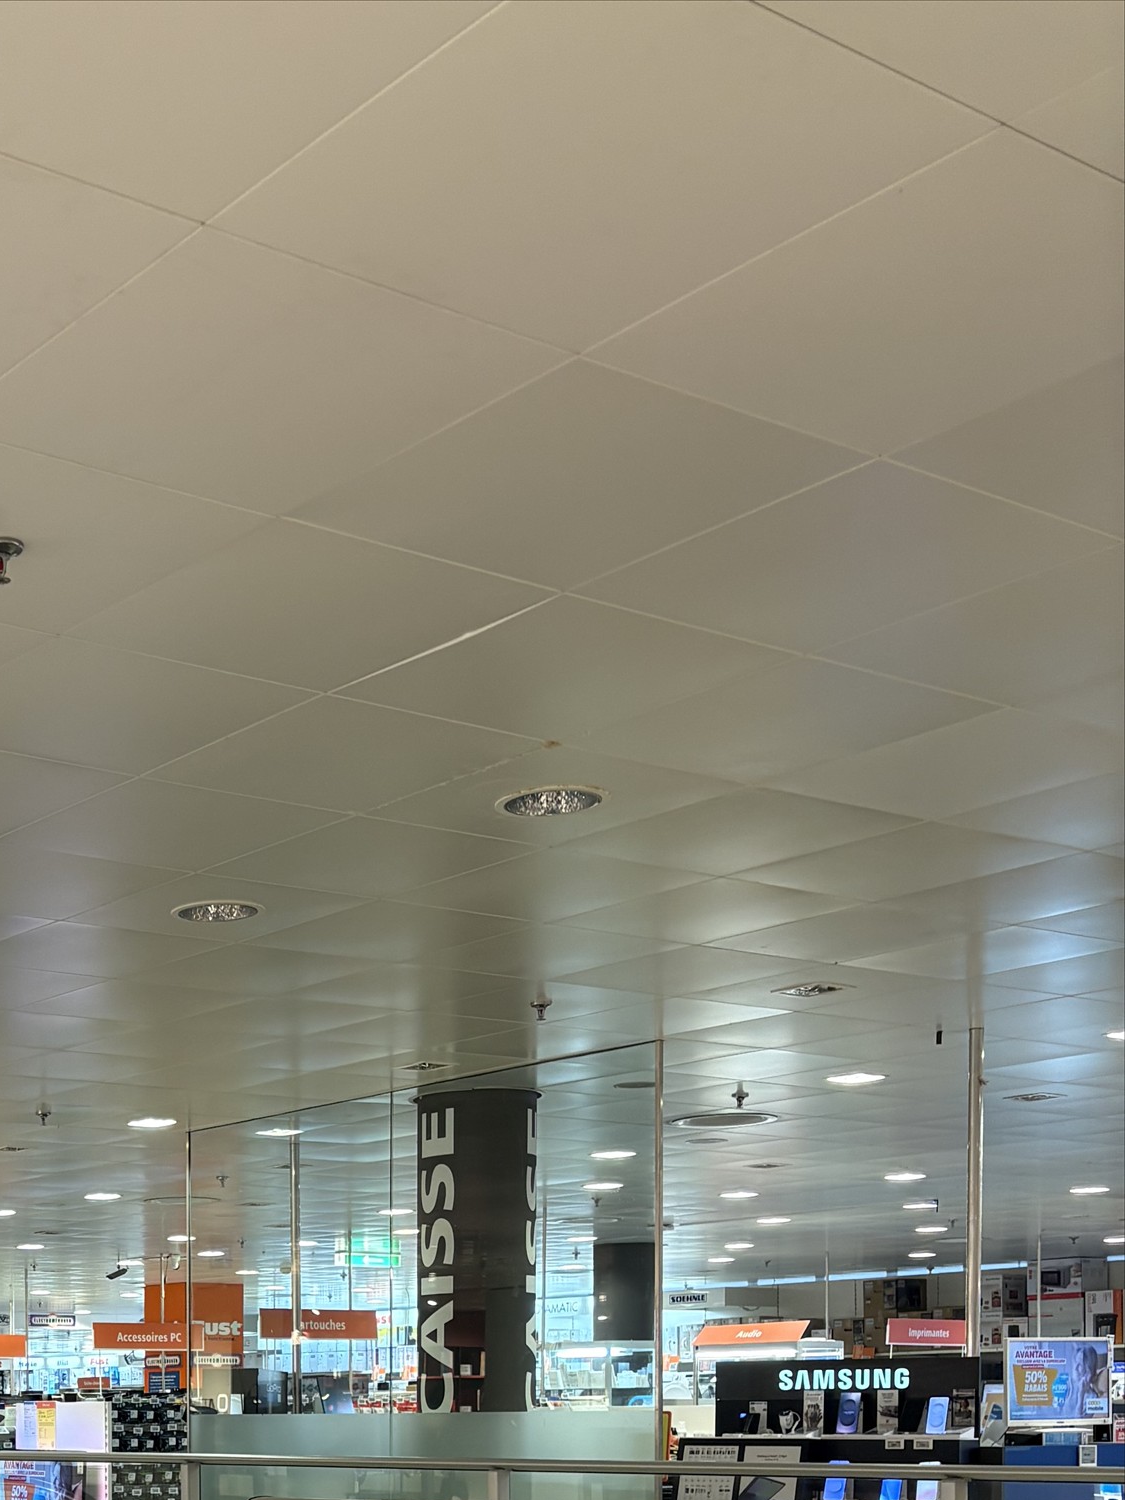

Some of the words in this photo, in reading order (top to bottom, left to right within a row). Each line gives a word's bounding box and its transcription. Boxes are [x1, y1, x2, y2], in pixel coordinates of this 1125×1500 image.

[421, 1107, 455, 1413] CAISSE
[300, 1319, 346, 1331] artouches
[117, 1332, 168, 1343] Accessoires
[169, 1333, 182, 1342] PC
[735, 1329, 762, 1338] Audio
[908, 1327, 950, 1338] Imprimantes
[778, 1368, 910, 1391] SAMSUNG
[1025, 1371, 1047, 1383] 50%
[1024, 1384, 1047, 1392] RABAIS
[12, 1485, 27, 1497] 50%
